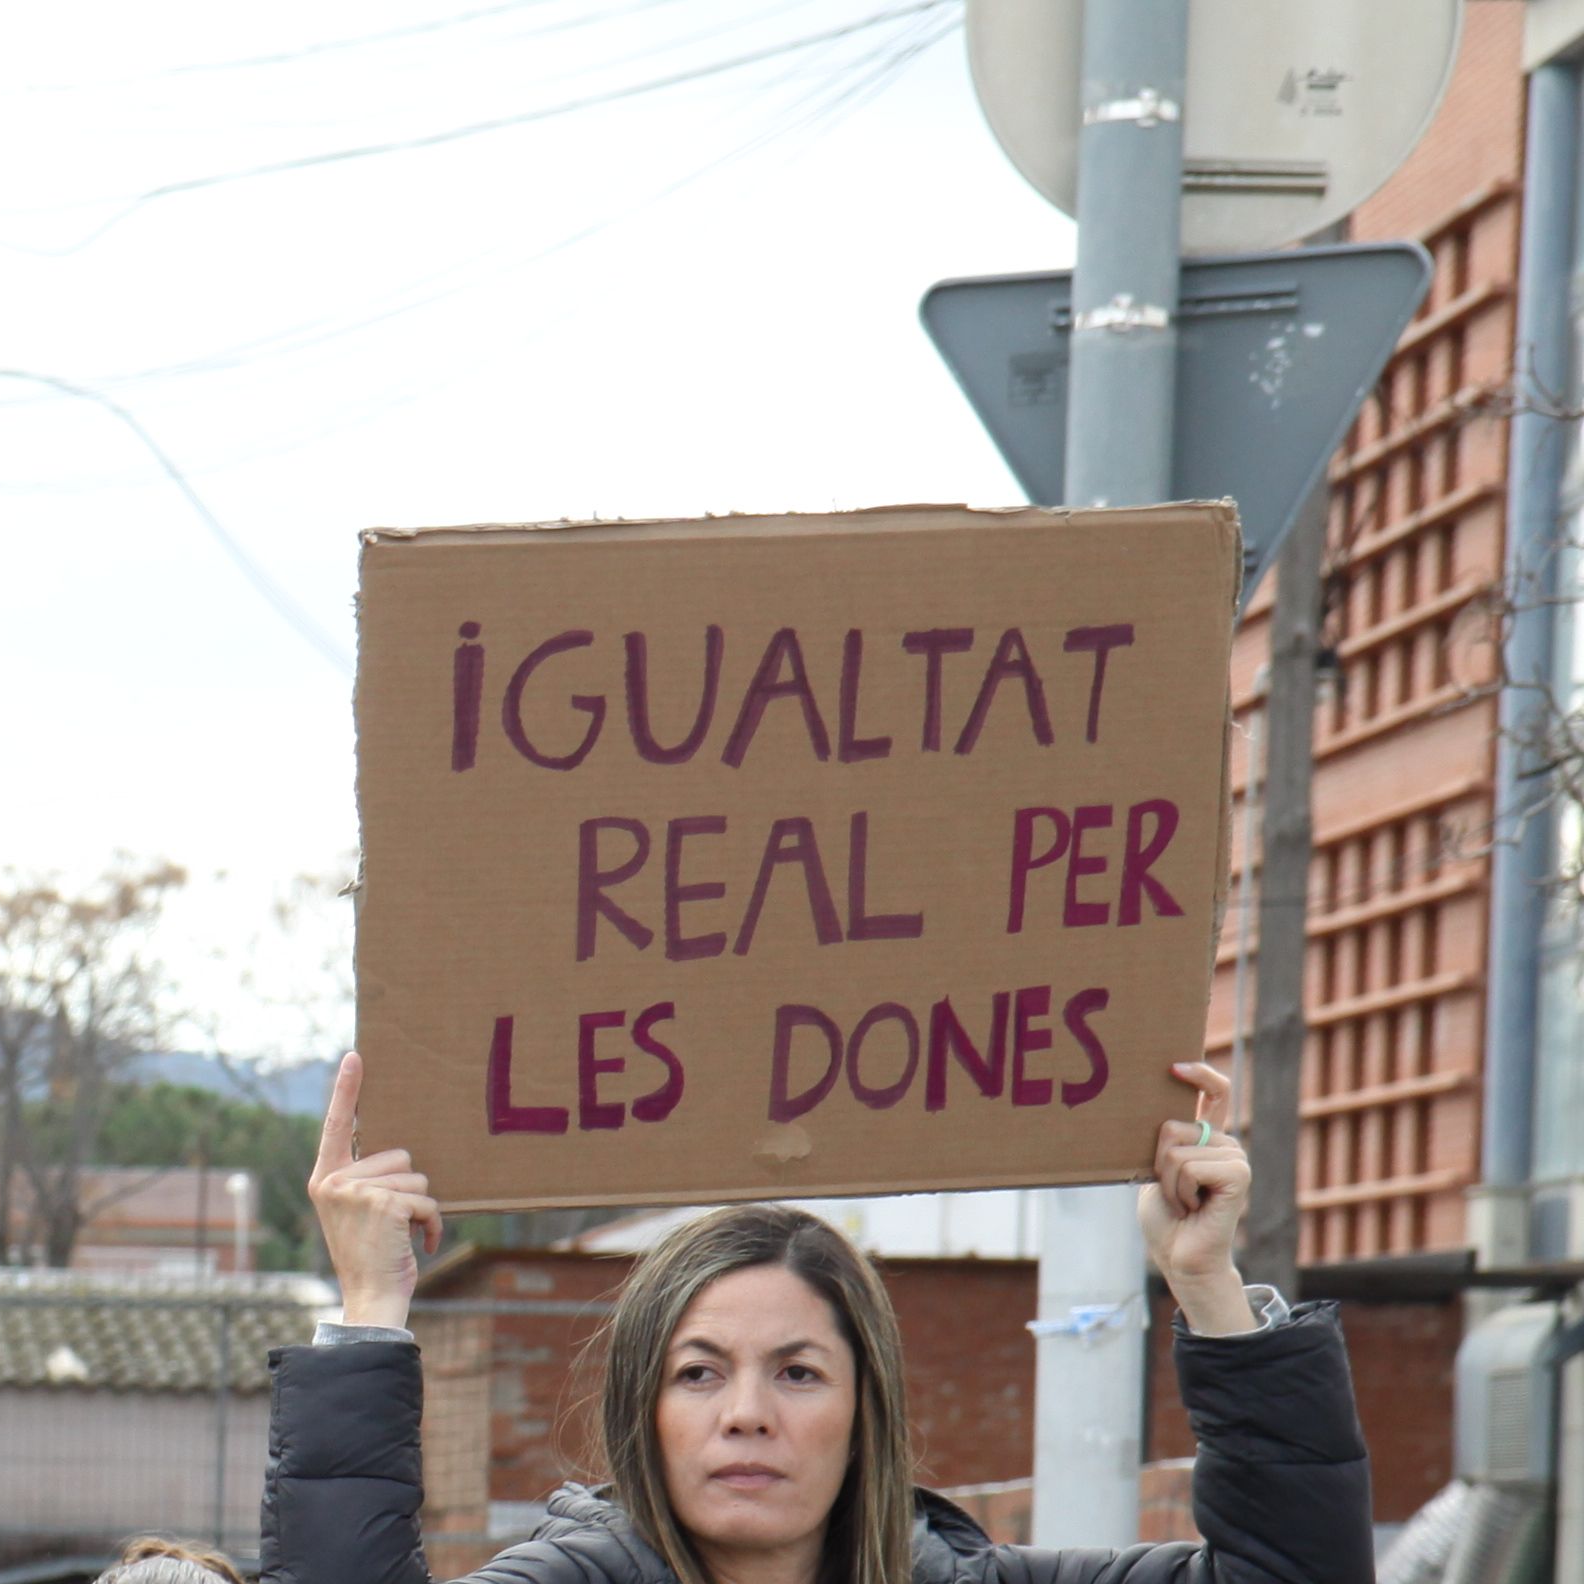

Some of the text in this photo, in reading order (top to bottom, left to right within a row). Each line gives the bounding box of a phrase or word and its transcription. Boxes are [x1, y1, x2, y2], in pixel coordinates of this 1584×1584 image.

[576, 799, 1186, 961] REAL PER
[485, 985, 1110, 1136] LES DONES
